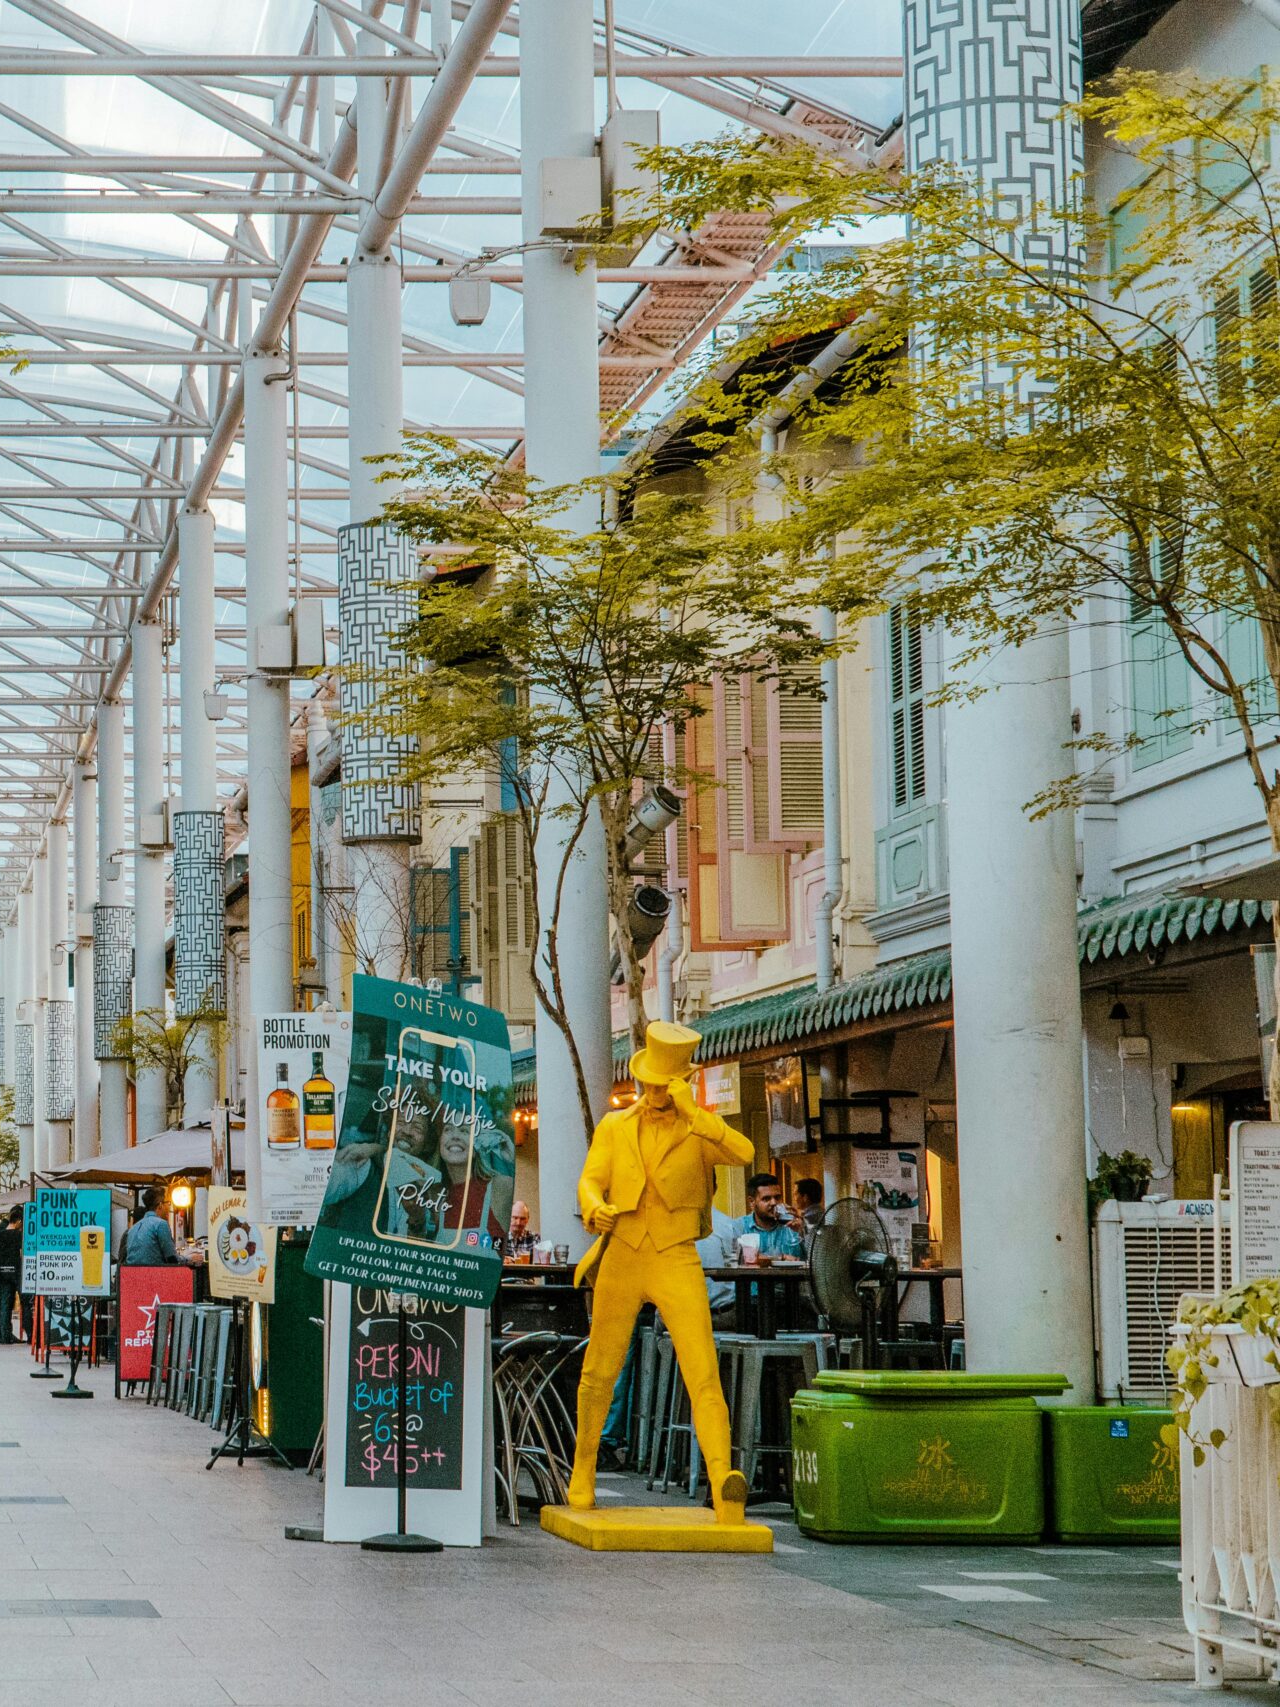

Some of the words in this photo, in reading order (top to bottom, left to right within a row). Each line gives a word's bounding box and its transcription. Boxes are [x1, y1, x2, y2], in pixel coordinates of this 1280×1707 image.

[263, 1018, 306, 1034] BOTTLE
[394, 992, 478, 1027] ONETWO
[263, 1034, 330, 1050] PROMOTION
[384, 1053, 433, 1080] TAKE
[438, 1065, 487, 1093] YOUR
[372, 1085, 431, 1124] Selfie
[443, 1102, 497, 1138] Wefie
[41, 1192, 78, 1209] PUNK
[396, 1176, 453, 1213] Photo
[41, 1211, 97, 1228] O'CLOCK
[338, 1236, 377, 1252] UPLOAD
[379, 1244, 392, 1254] TO
[394, 1247, 418, 1260] YOUR
[419, 1251, 451, 1266] SOCIAL
[453, 1257, 480, 1271] MEDIA
[391, 1260, 414, 1274] LIKE
[416, 1264, 424, 1274] &
[425, 1266, 445, 1279] TAG
[446, 1270, 457, 1281] US
[61, 1274, 74, 1282] pint
[318, 1260, 339, 1273] GET
[341, 1265, 368, 1280] YOUR
[370, 1269, 452, 1293] COMPLIMENTARY
[453, 1285, 483, 1300] SHOTS
[355, 1343, 440, 1380] PERONI
[429, 1382, 454, 1415] of
[374, 1412, 391, 1442] 6
[405, 1414, 423, 1441] @
[361, 1441, 446, 1481] $45++
[794, 1448, 818, 1484] 2139
